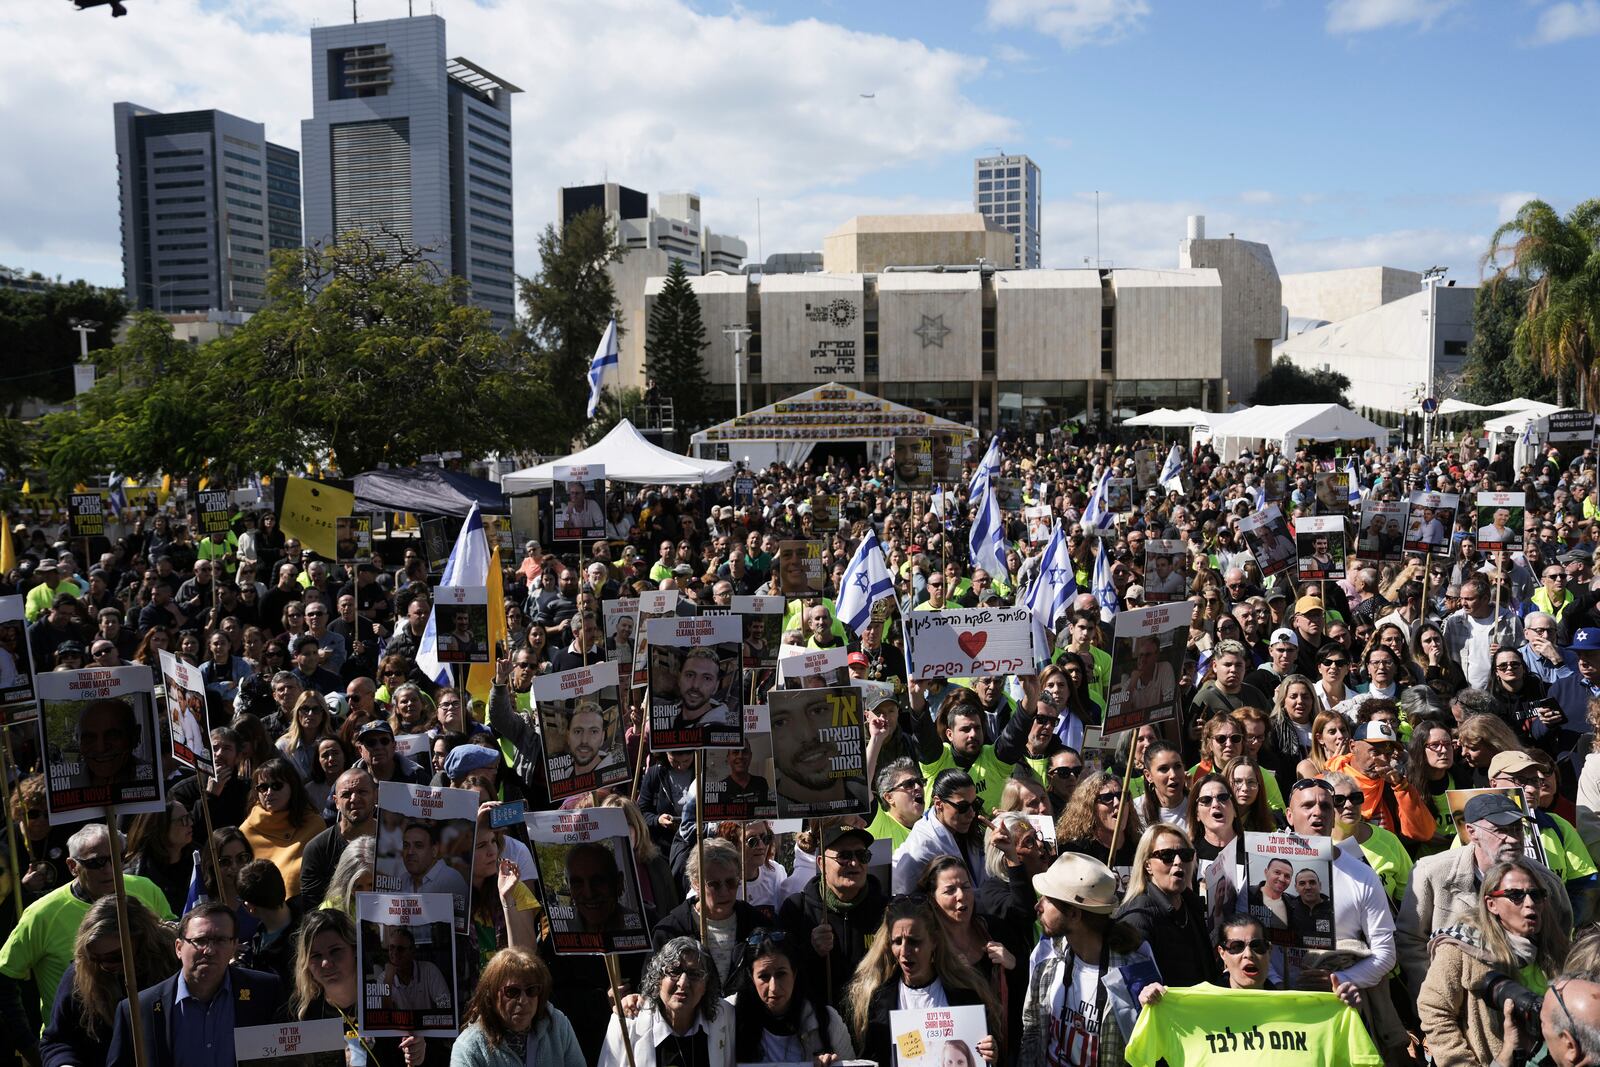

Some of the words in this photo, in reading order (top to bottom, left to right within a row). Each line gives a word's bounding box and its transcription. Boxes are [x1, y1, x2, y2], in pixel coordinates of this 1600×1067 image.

[819, 341, 855, 349] ספריית
[837, 357, 855, 365] בית
[72, 495, 101, 505] אוהבים
[200, 492, 227, 504] אוהבים
[79, 505, 101, 515] אתכם
[206, 502, 227, 512] אתכם
[806, 543, 820, 559] אל
[932, 615, 961, 626] הרבה
[997, 609, 1027, 623] סליחה
[676, 629, 695, 637] ELKANA
[696, 627, 715, 637] BOHBOT
[915, 616, 931, 636] זמן
[922, 662, 963, 678] השבים
[971, 658, 1024, 674] ברוכים
[69, 681, 92, 690] SHLOMO
[93, 679, 121, 688] MANTZUR
[560, 680, 577, 690] ELKANA
[1110, 690, 1130, 706] BRING
[653, 705, 678, 718] BRING
[826, 694, 859, 727] אל
[1108, 704, 1121, 717] HIM
[653, 718, 669, 730] HIM
[818, 725, 860, 743] תשאירו
[836, 740, 861, 756] אותי
[548, 754, 572, 770] BRING
[829, 754, 862, 771] מאחור
[50, 762, 80, 778] BRING
[550, 767, 565, 782] HIM
[51, 778, 71, 791] HIM
[705, 782, 727, 793] BRING
[420, 800, 443, 808] SHARABI
[705, 793, 719, 803] HIM
[421, 808, 432, 817] (51)
[552, 824, 573, 833] SHLOMO
[574, 822, 599, 832] MANTZUR
[564, 833, 579, 842] (86)
[1294, 848, 1319, 856] SHARABI
[376, 875, 401, 891] BRING
[388, 907, 401, 915] OHAD
[401, 907, 412, 915] BEN
[412, 907, 422, 915] AMI
[549, 906, 574, 920] BRING
[552, 919, 569, 932] HIM
[366, 983, 390, 996] BRING
[366, 996, 383, 1009] HIM
[925, 1021, 938, 1029] SHIRI
[939, 1020, 954, 1028] BIBAS
[279, 1036, 287, 1044] OR
[288, 1035, 301, 1044] LEVY
[926, 1029, 942, 1038] (33)
[1205, 1026, 1238, 1053] לבד
[1241, 1025, 1265, 1051] לא
[1269, 1031, 1308, 1051] אתם
